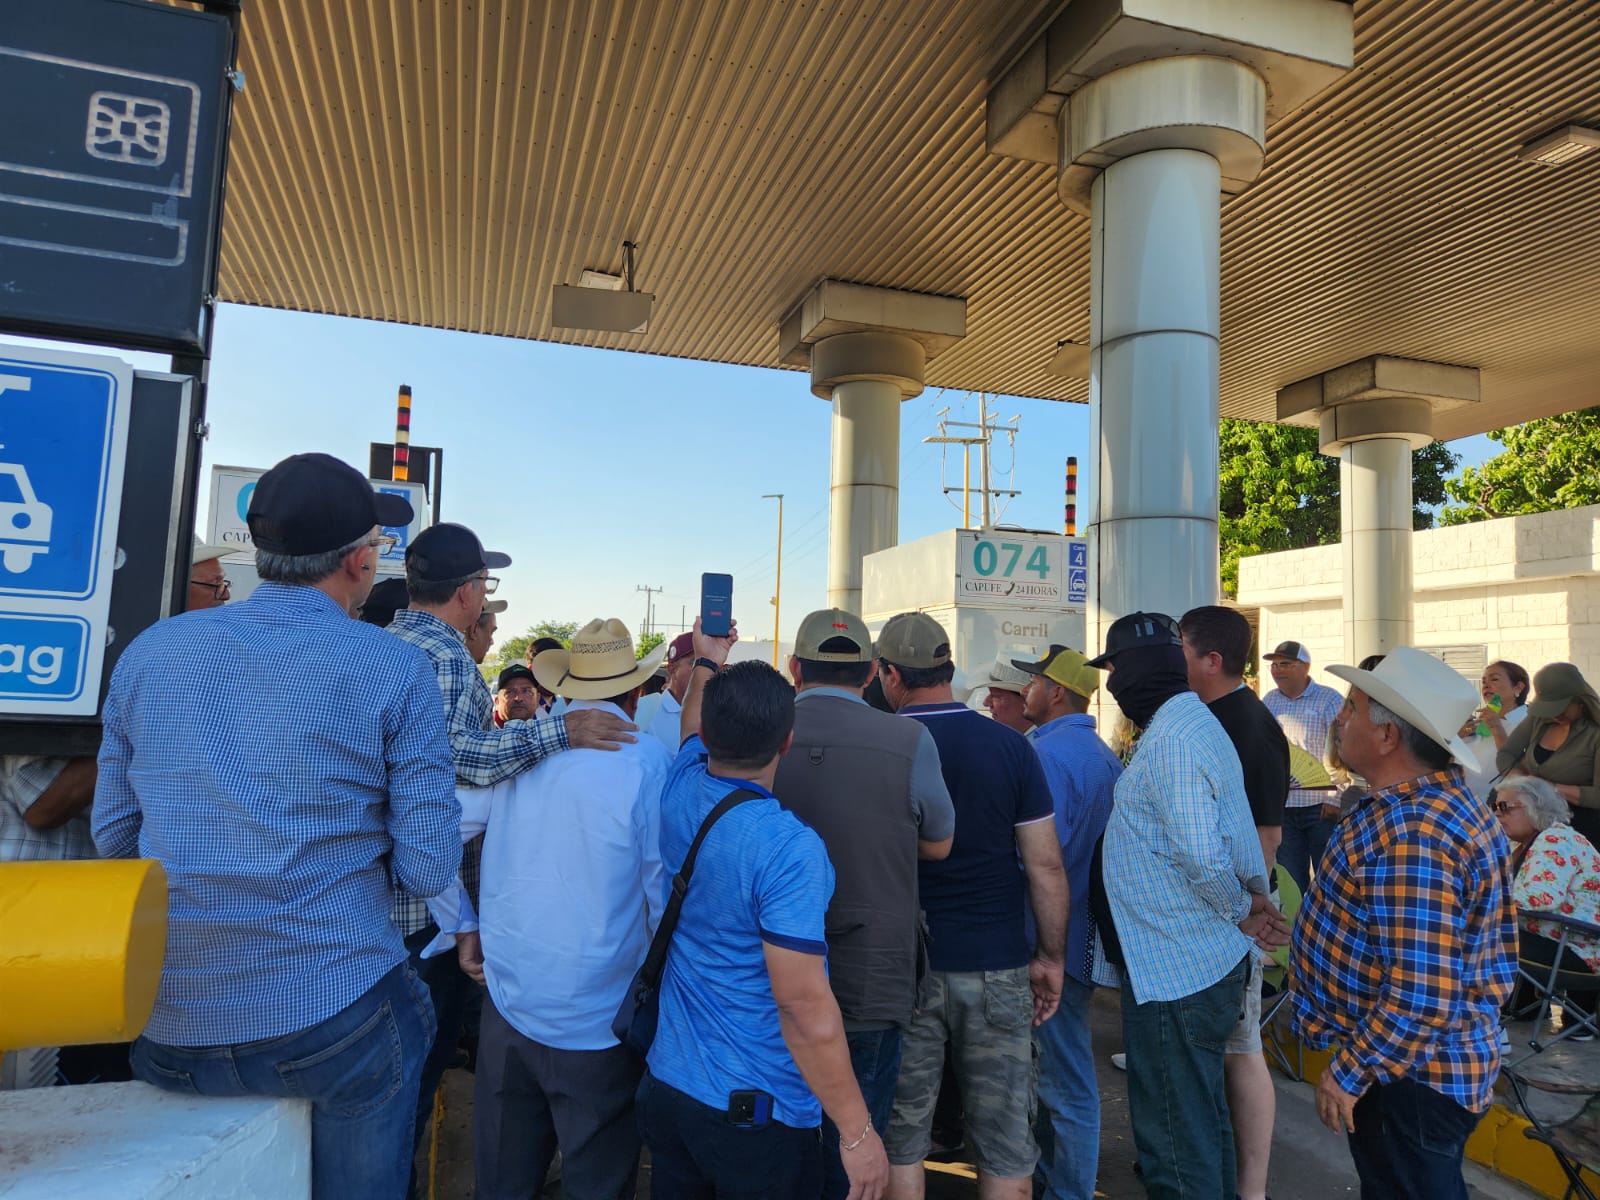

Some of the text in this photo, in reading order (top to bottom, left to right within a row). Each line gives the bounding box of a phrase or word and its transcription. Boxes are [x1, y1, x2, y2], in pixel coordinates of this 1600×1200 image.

[973, 541, 1051, 580] 074
[1075, 551, 1083, 566] 4
[965, 582, 1058, 596] CAPUFE 24 HORAS
[1001, 620, 1048, 638] Carril
[0, 643, 64, 685] ag
